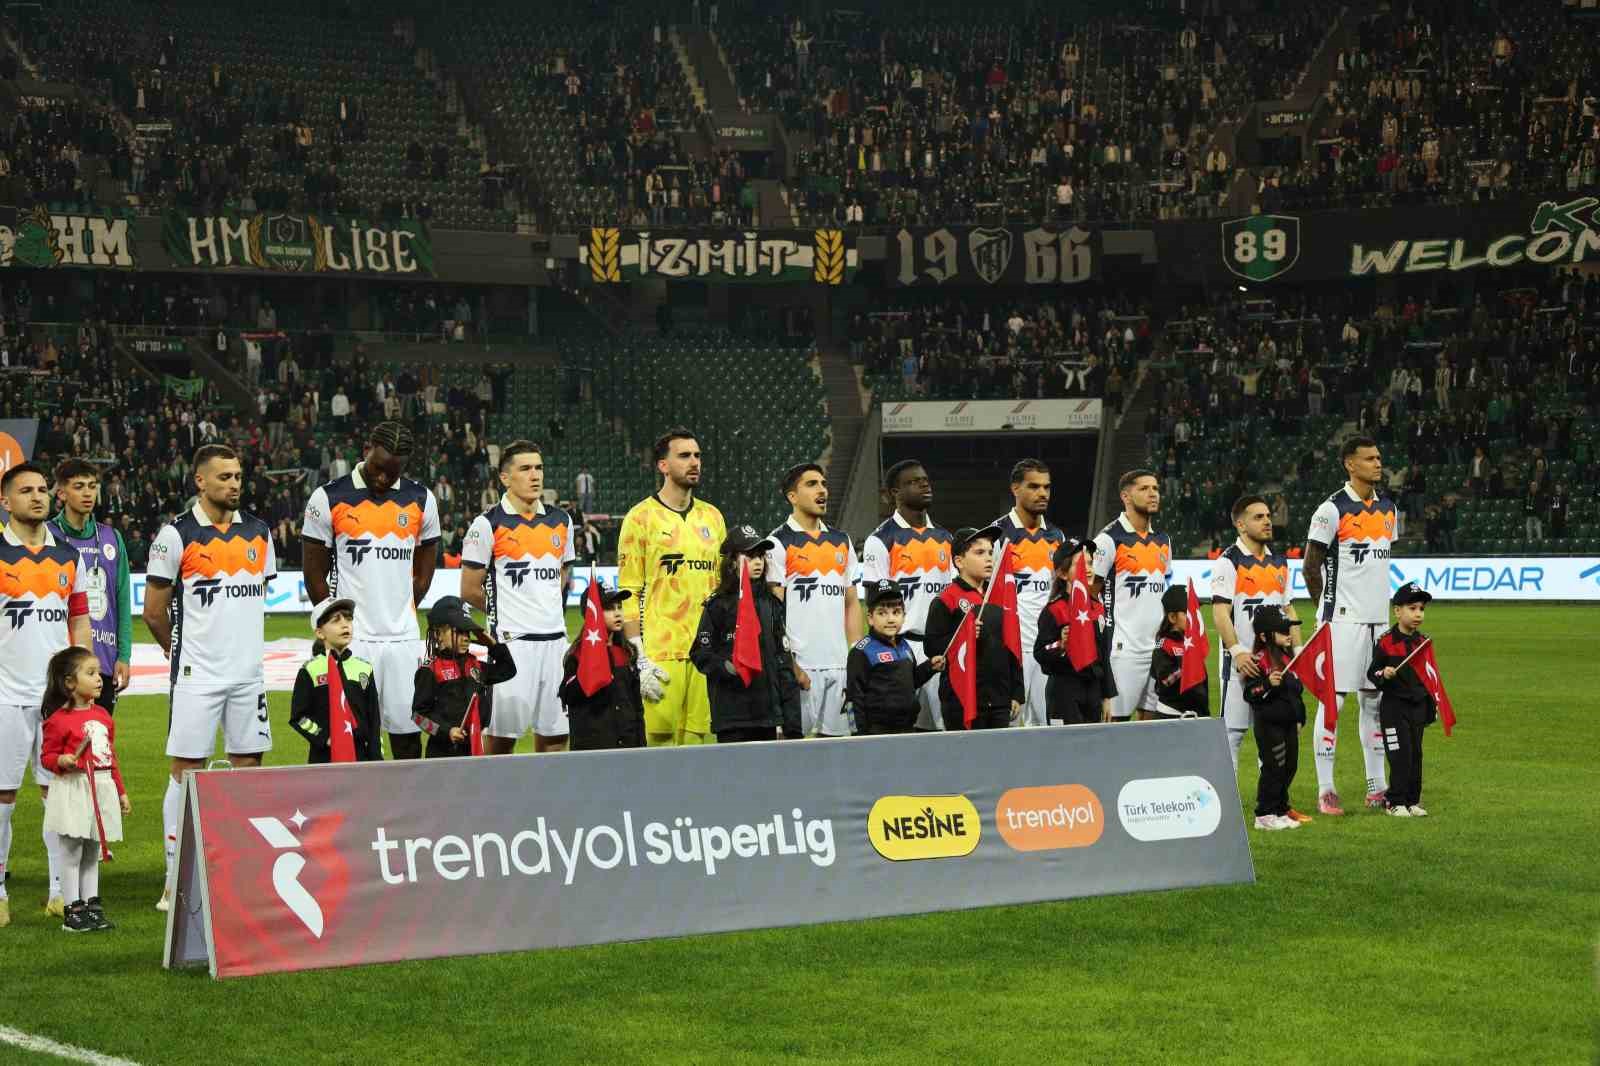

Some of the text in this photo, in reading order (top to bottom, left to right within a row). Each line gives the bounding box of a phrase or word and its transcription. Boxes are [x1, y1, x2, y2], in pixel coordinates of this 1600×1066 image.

[187, 217, 253, 265] HM
[896, 226, 1092, 286] 19 66
[1234, 229, 1287, 263] 89
[224, 583, 263, 599] TODINI
[1424, 566, 1544, 592] MEDAR
[257, 692, 268, 722] 5
[1006, 801, 1096, 830] trendyol
[1150, 800, 1196, 814] Telekom
[371, 807, 836, 886] trendyol süperLig
